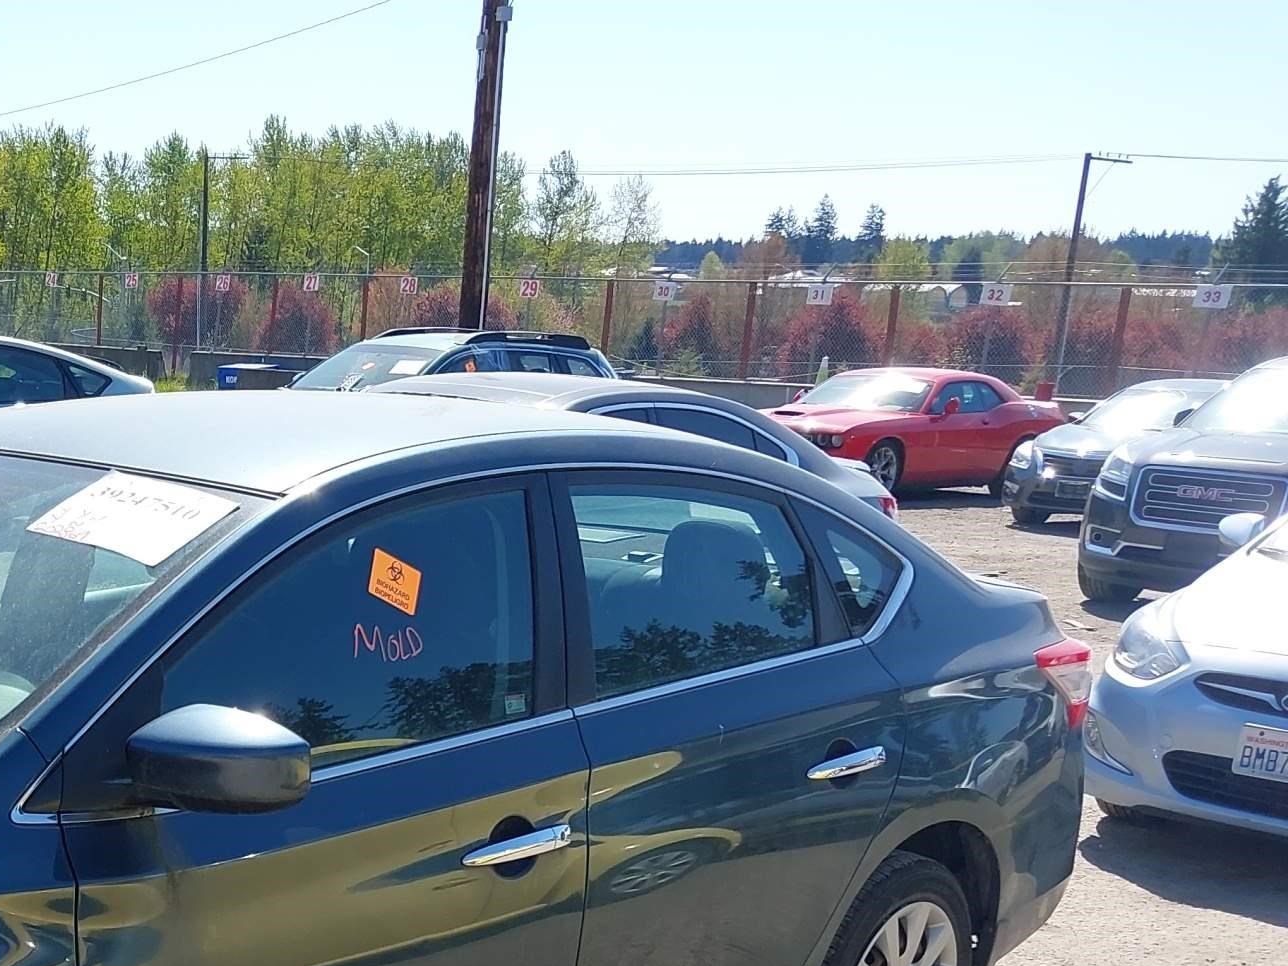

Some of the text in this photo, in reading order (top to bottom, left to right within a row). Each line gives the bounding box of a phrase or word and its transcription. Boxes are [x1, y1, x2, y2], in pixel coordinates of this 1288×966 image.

[46, 273, 56, 286] 24
[126, 275, 137, 287] 25
[217, 276, 230, 290] 26
[306, 276, 318, 290] 27
[402, 278, 416, 293] 28
[522, 280, 538, 297] 29
[658, 286, 670, 297] 30
[812, 290, 825, 301] 31
[987, 289, 1004, 301] 32
[1202, 291, 1222, 303] 33
[1176, 484, 1235, 502] GMC
[376, 578, 410, 601] BIOHAZARD
[374, 586, 409, 610] BIOPELIGRO
[354, 623, 423, 662] MOLD
